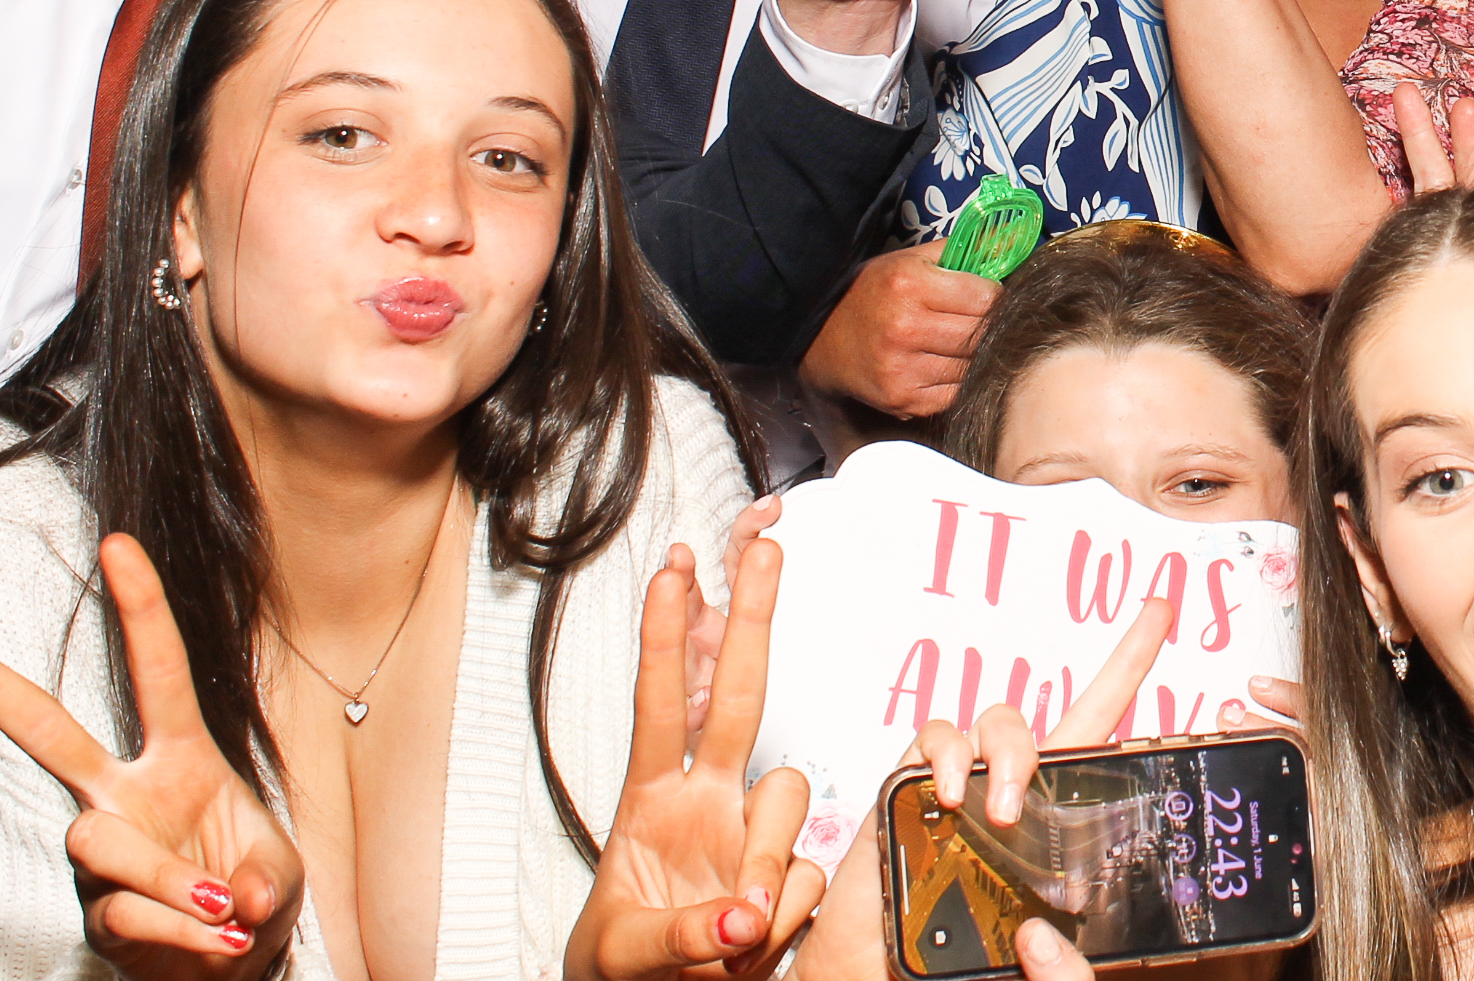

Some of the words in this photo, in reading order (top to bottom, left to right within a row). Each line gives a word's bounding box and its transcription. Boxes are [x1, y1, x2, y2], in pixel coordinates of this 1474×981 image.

[922, 498, 1027, 607] IT
[1066, 529, 1242, 653] WAS
[1205, 788, 1248, 899] 22:43
[1250, 801, 1260, 847] Saturday,
[1254, 855, 1263, 880] June
